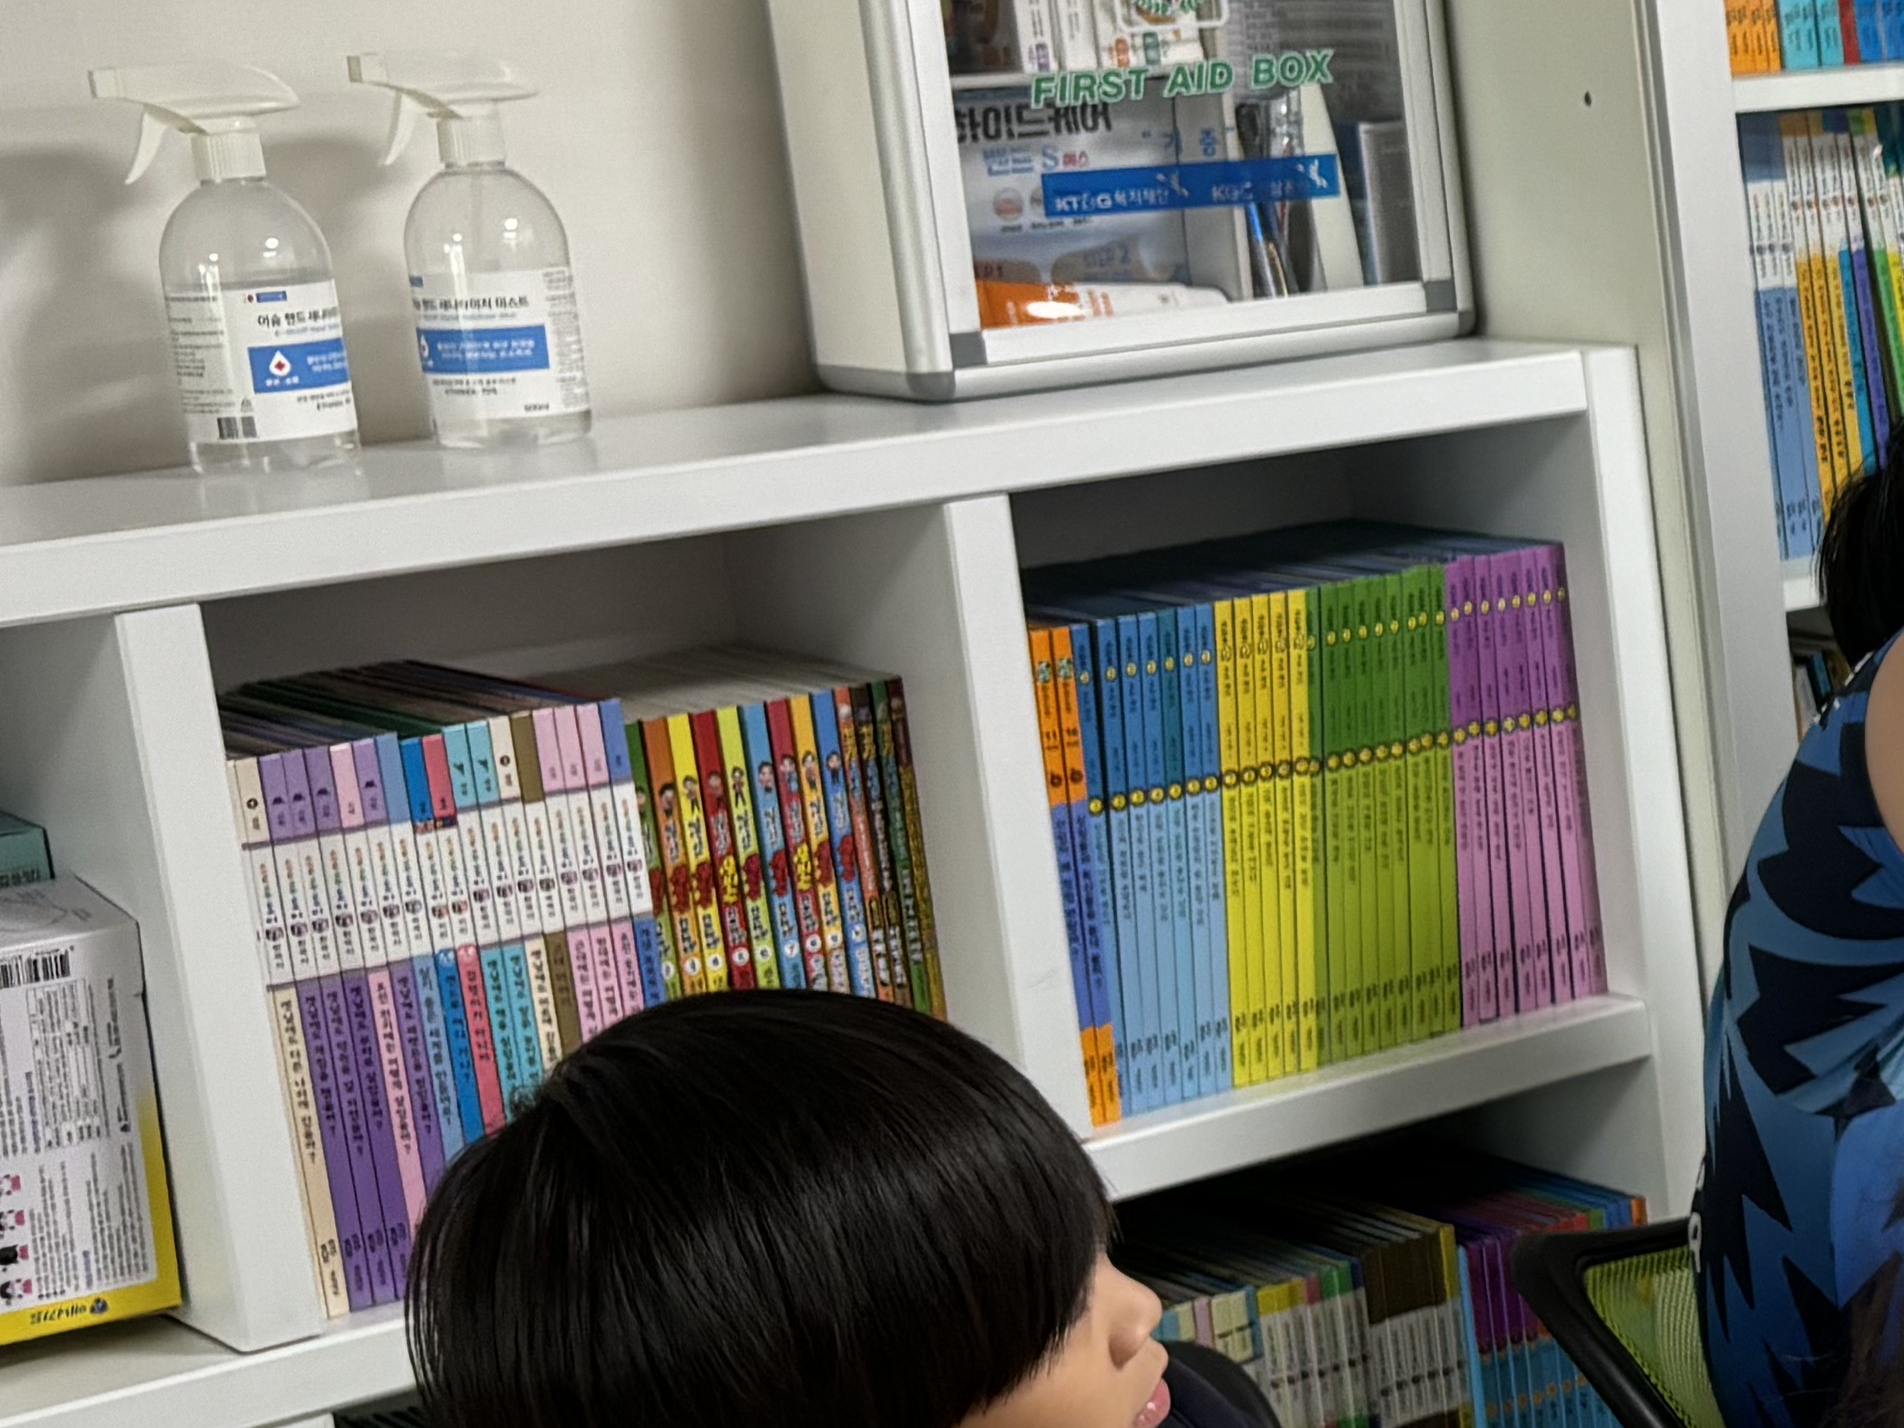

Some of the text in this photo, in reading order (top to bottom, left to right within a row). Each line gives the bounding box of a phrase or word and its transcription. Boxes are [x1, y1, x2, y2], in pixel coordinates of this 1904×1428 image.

[1031, 48, 1336, 109] FIRST AID BOX
